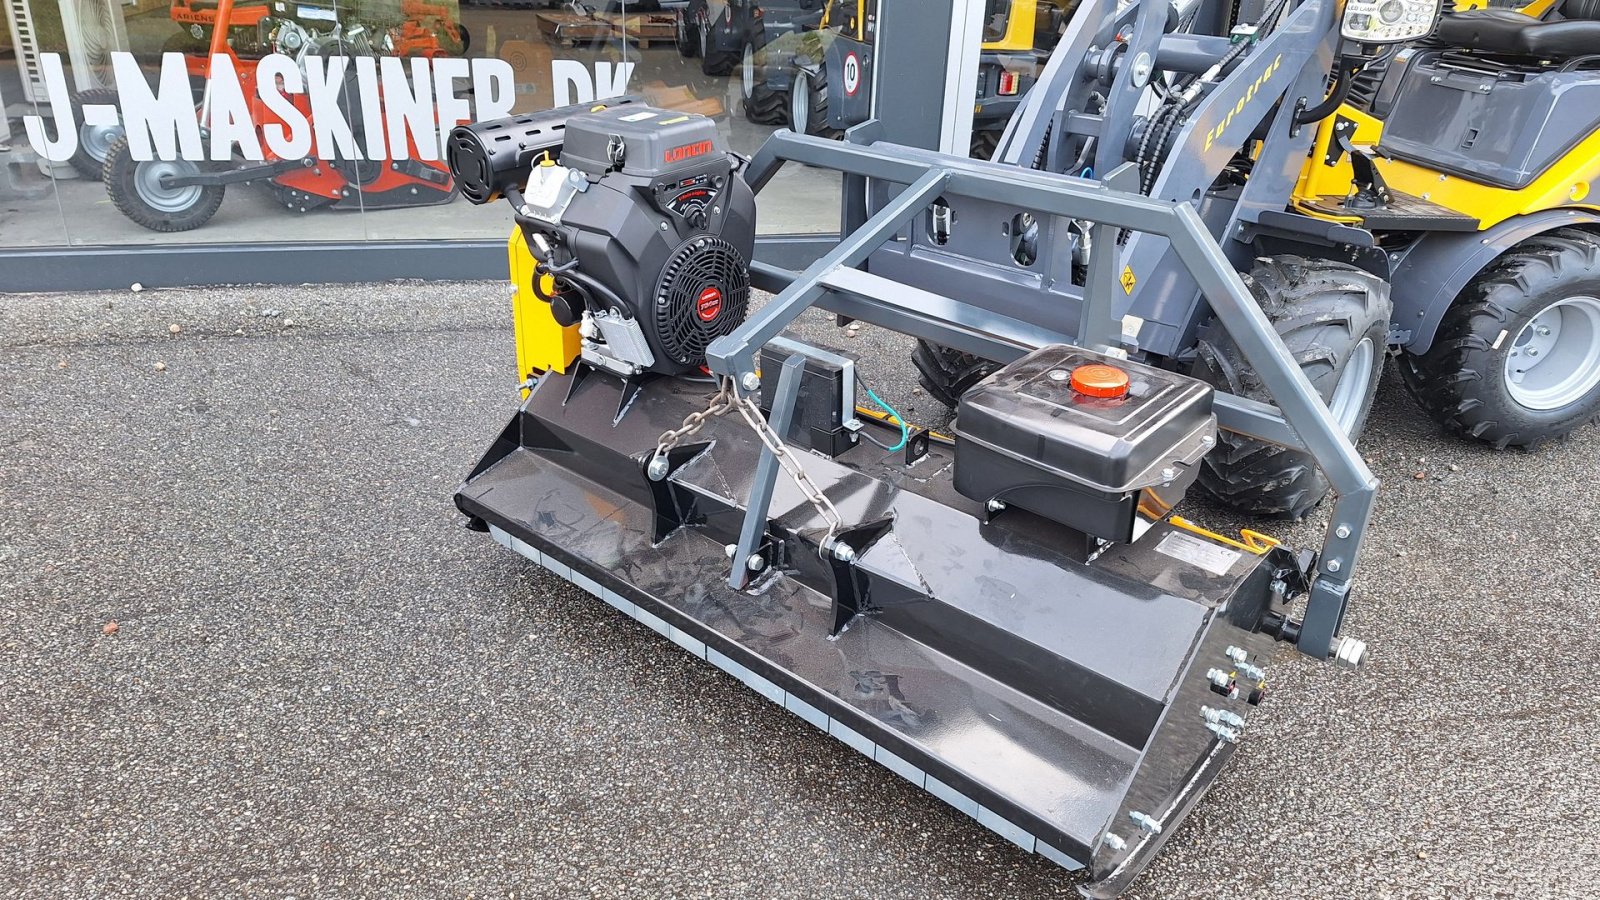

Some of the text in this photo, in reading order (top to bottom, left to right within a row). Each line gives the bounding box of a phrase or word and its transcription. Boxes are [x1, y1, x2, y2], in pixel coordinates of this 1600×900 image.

[846, 63, 855, 81] 10
[23, 52, 516, 162] J-MASKINER
[1204, 53, 1282, 153] Eurotrac
[664, 140, 712, 162] LONCIN
